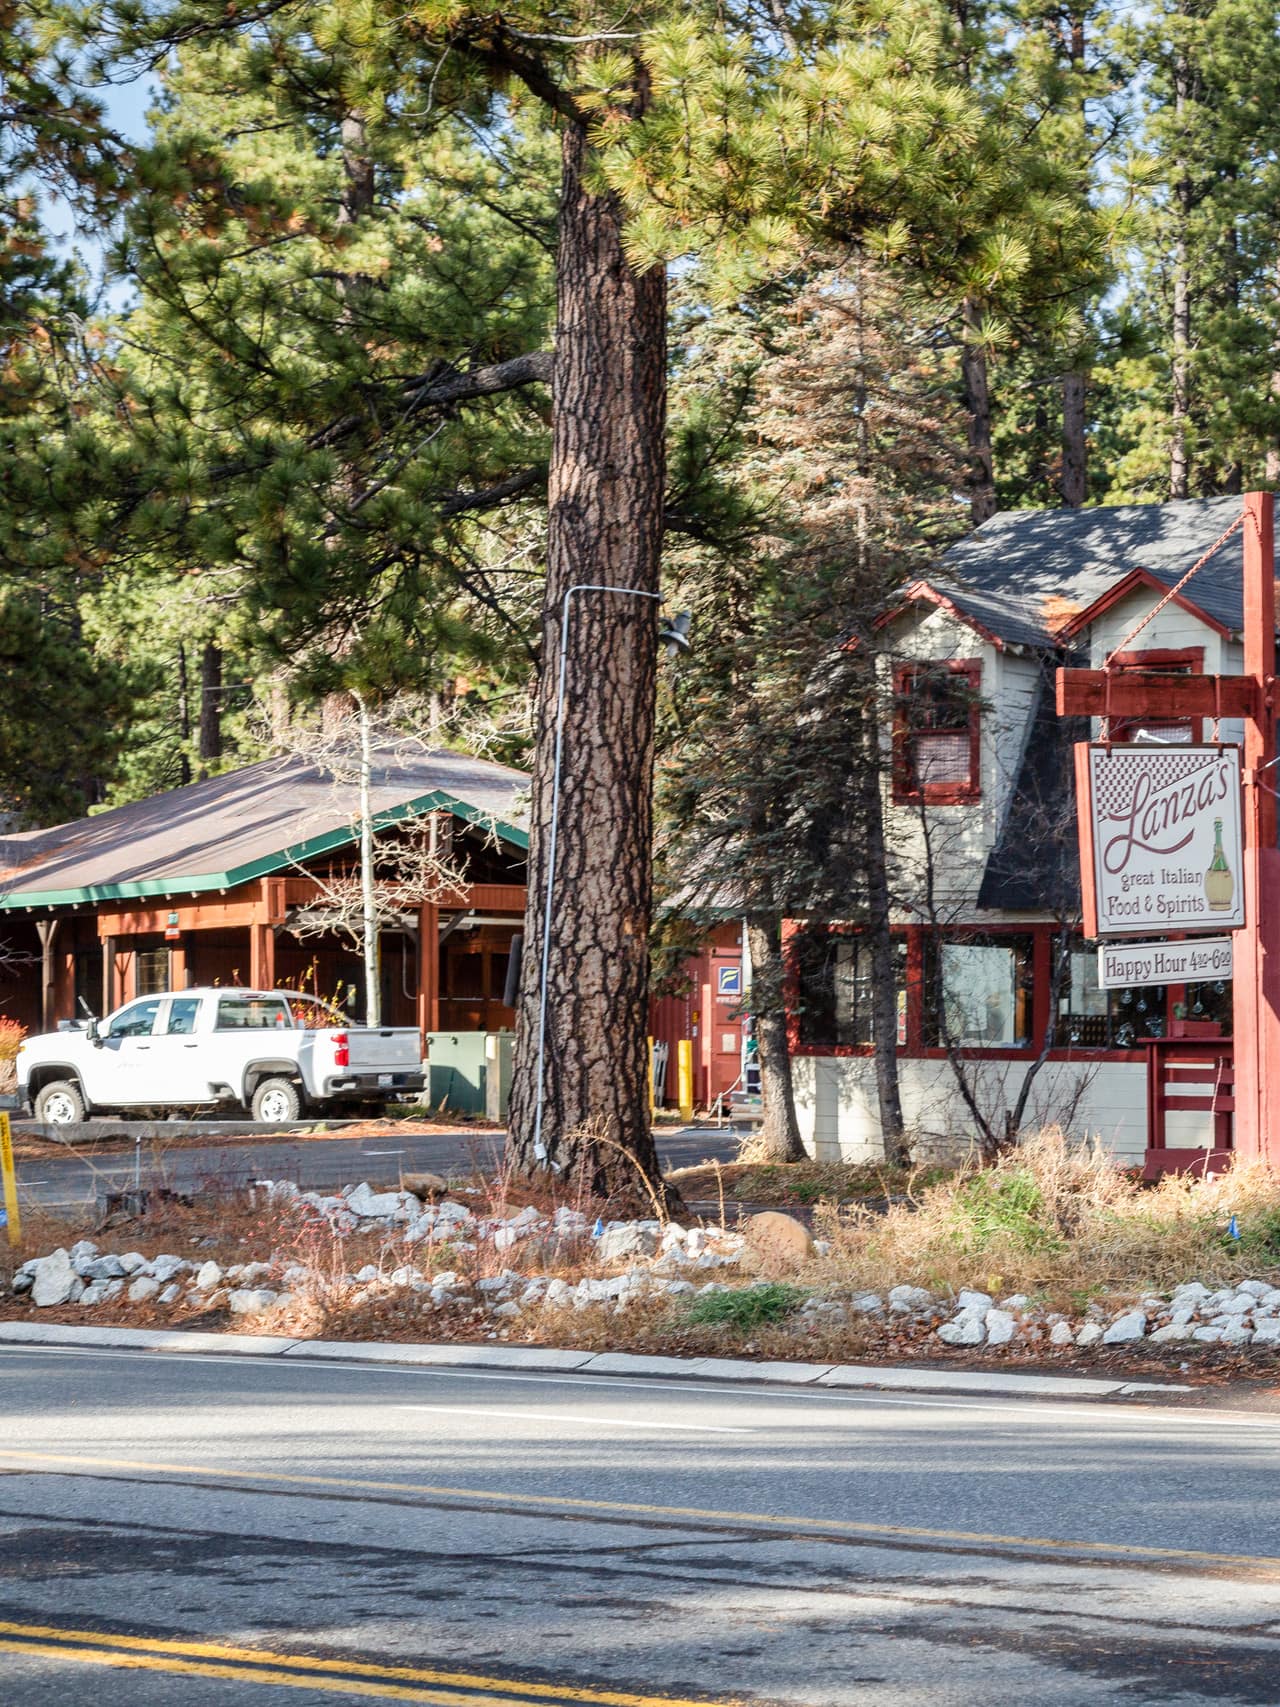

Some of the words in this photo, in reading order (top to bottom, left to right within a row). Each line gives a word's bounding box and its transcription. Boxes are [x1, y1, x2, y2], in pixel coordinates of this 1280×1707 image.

[1103, 763, 1229, 875] Lanza's
[1121, 870, 1155, 892] great
[1161, 867, 1203, 886] Italian
[1107, 896, 1141, 917] Food
[1144, 896, 1153, 912] &
[1156, 894, 1206, 919] Spirits
[1105, 954, 1151, 981] Happy
[1154, 950, 1187, 974] Hour
